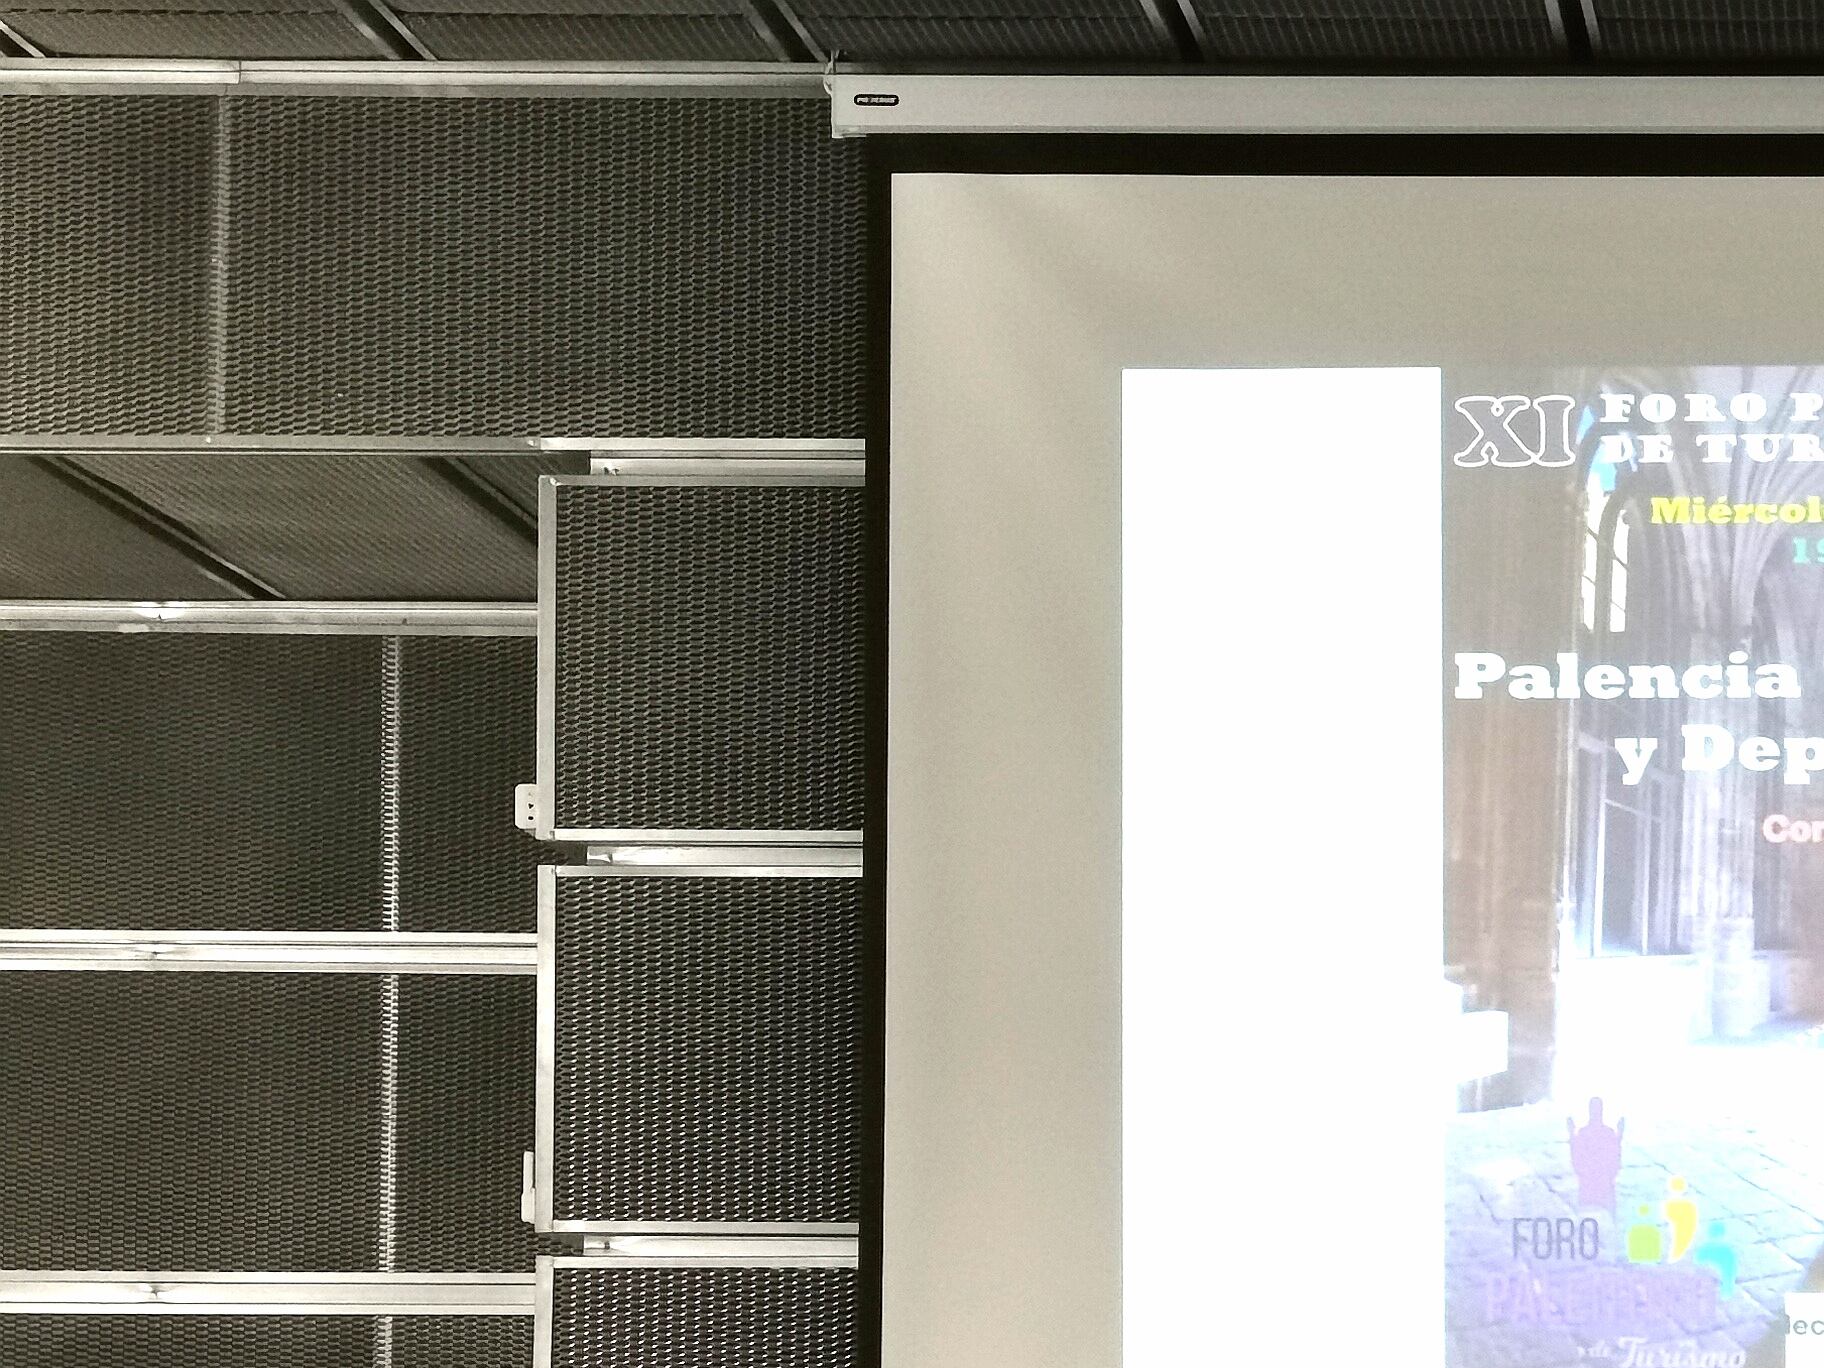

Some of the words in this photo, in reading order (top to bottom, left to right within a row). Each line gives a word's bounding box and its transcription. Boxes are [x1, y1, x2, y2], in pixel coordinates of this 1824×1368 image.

[1600, 393, 1768, 423] FORO
[1453, 395, 1576, 467] XI
[1600, 434, 1673, 464] DE
[1454, 652, 1802, 699] Palencia
[1614, 738, 1658, 785] y
[1511, 1217, 1600, 1260] FORO
